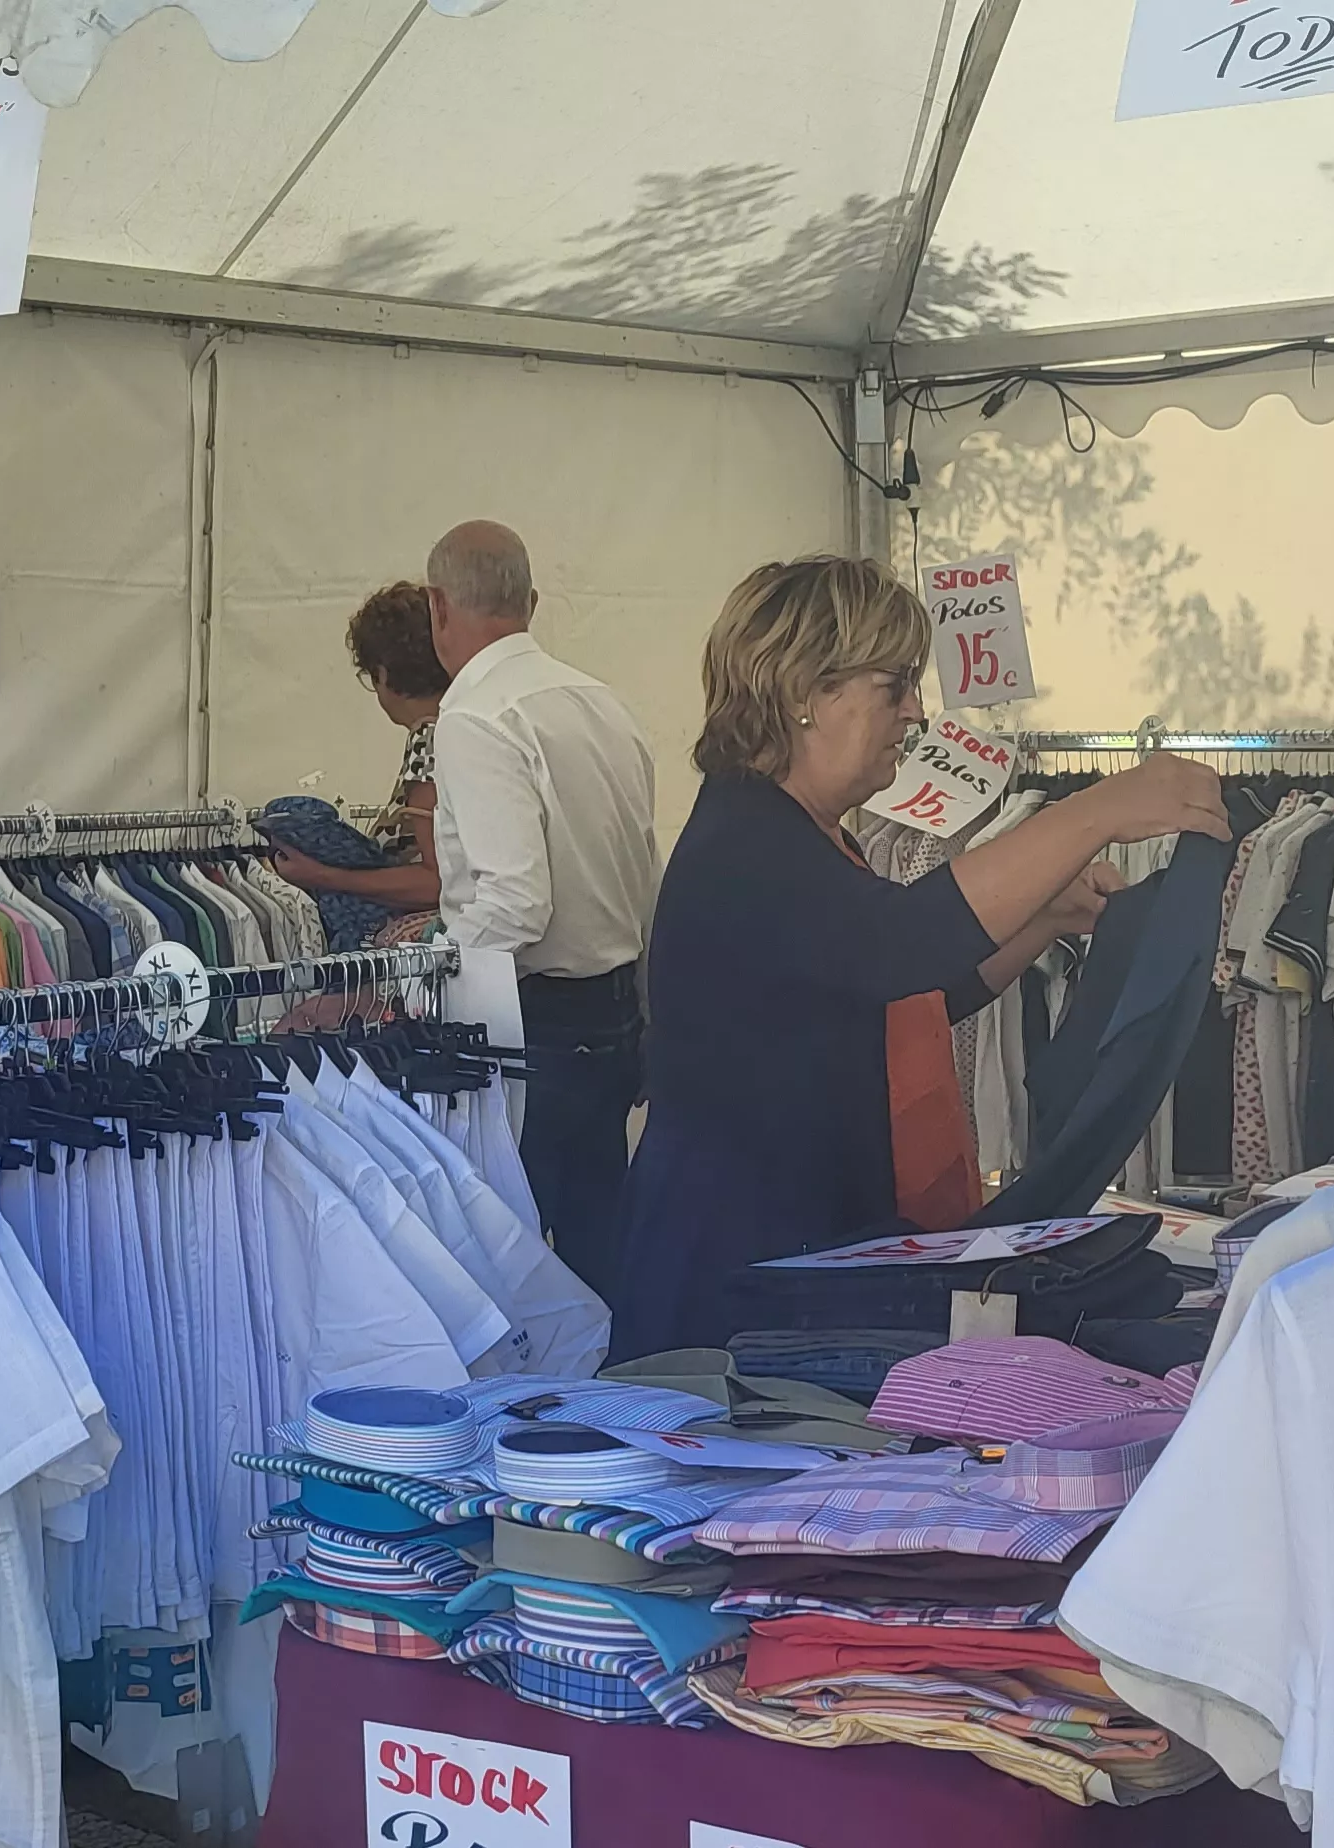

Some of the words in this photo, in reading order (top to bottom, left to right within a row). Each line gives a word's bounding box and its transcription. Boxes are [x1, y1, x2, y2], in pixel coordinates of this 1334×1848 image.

[931, 563, 1016, 590] STOCK
[937, 720, 1011, 772] STOCK
[376, 1739, 550, 1826] STOCK
